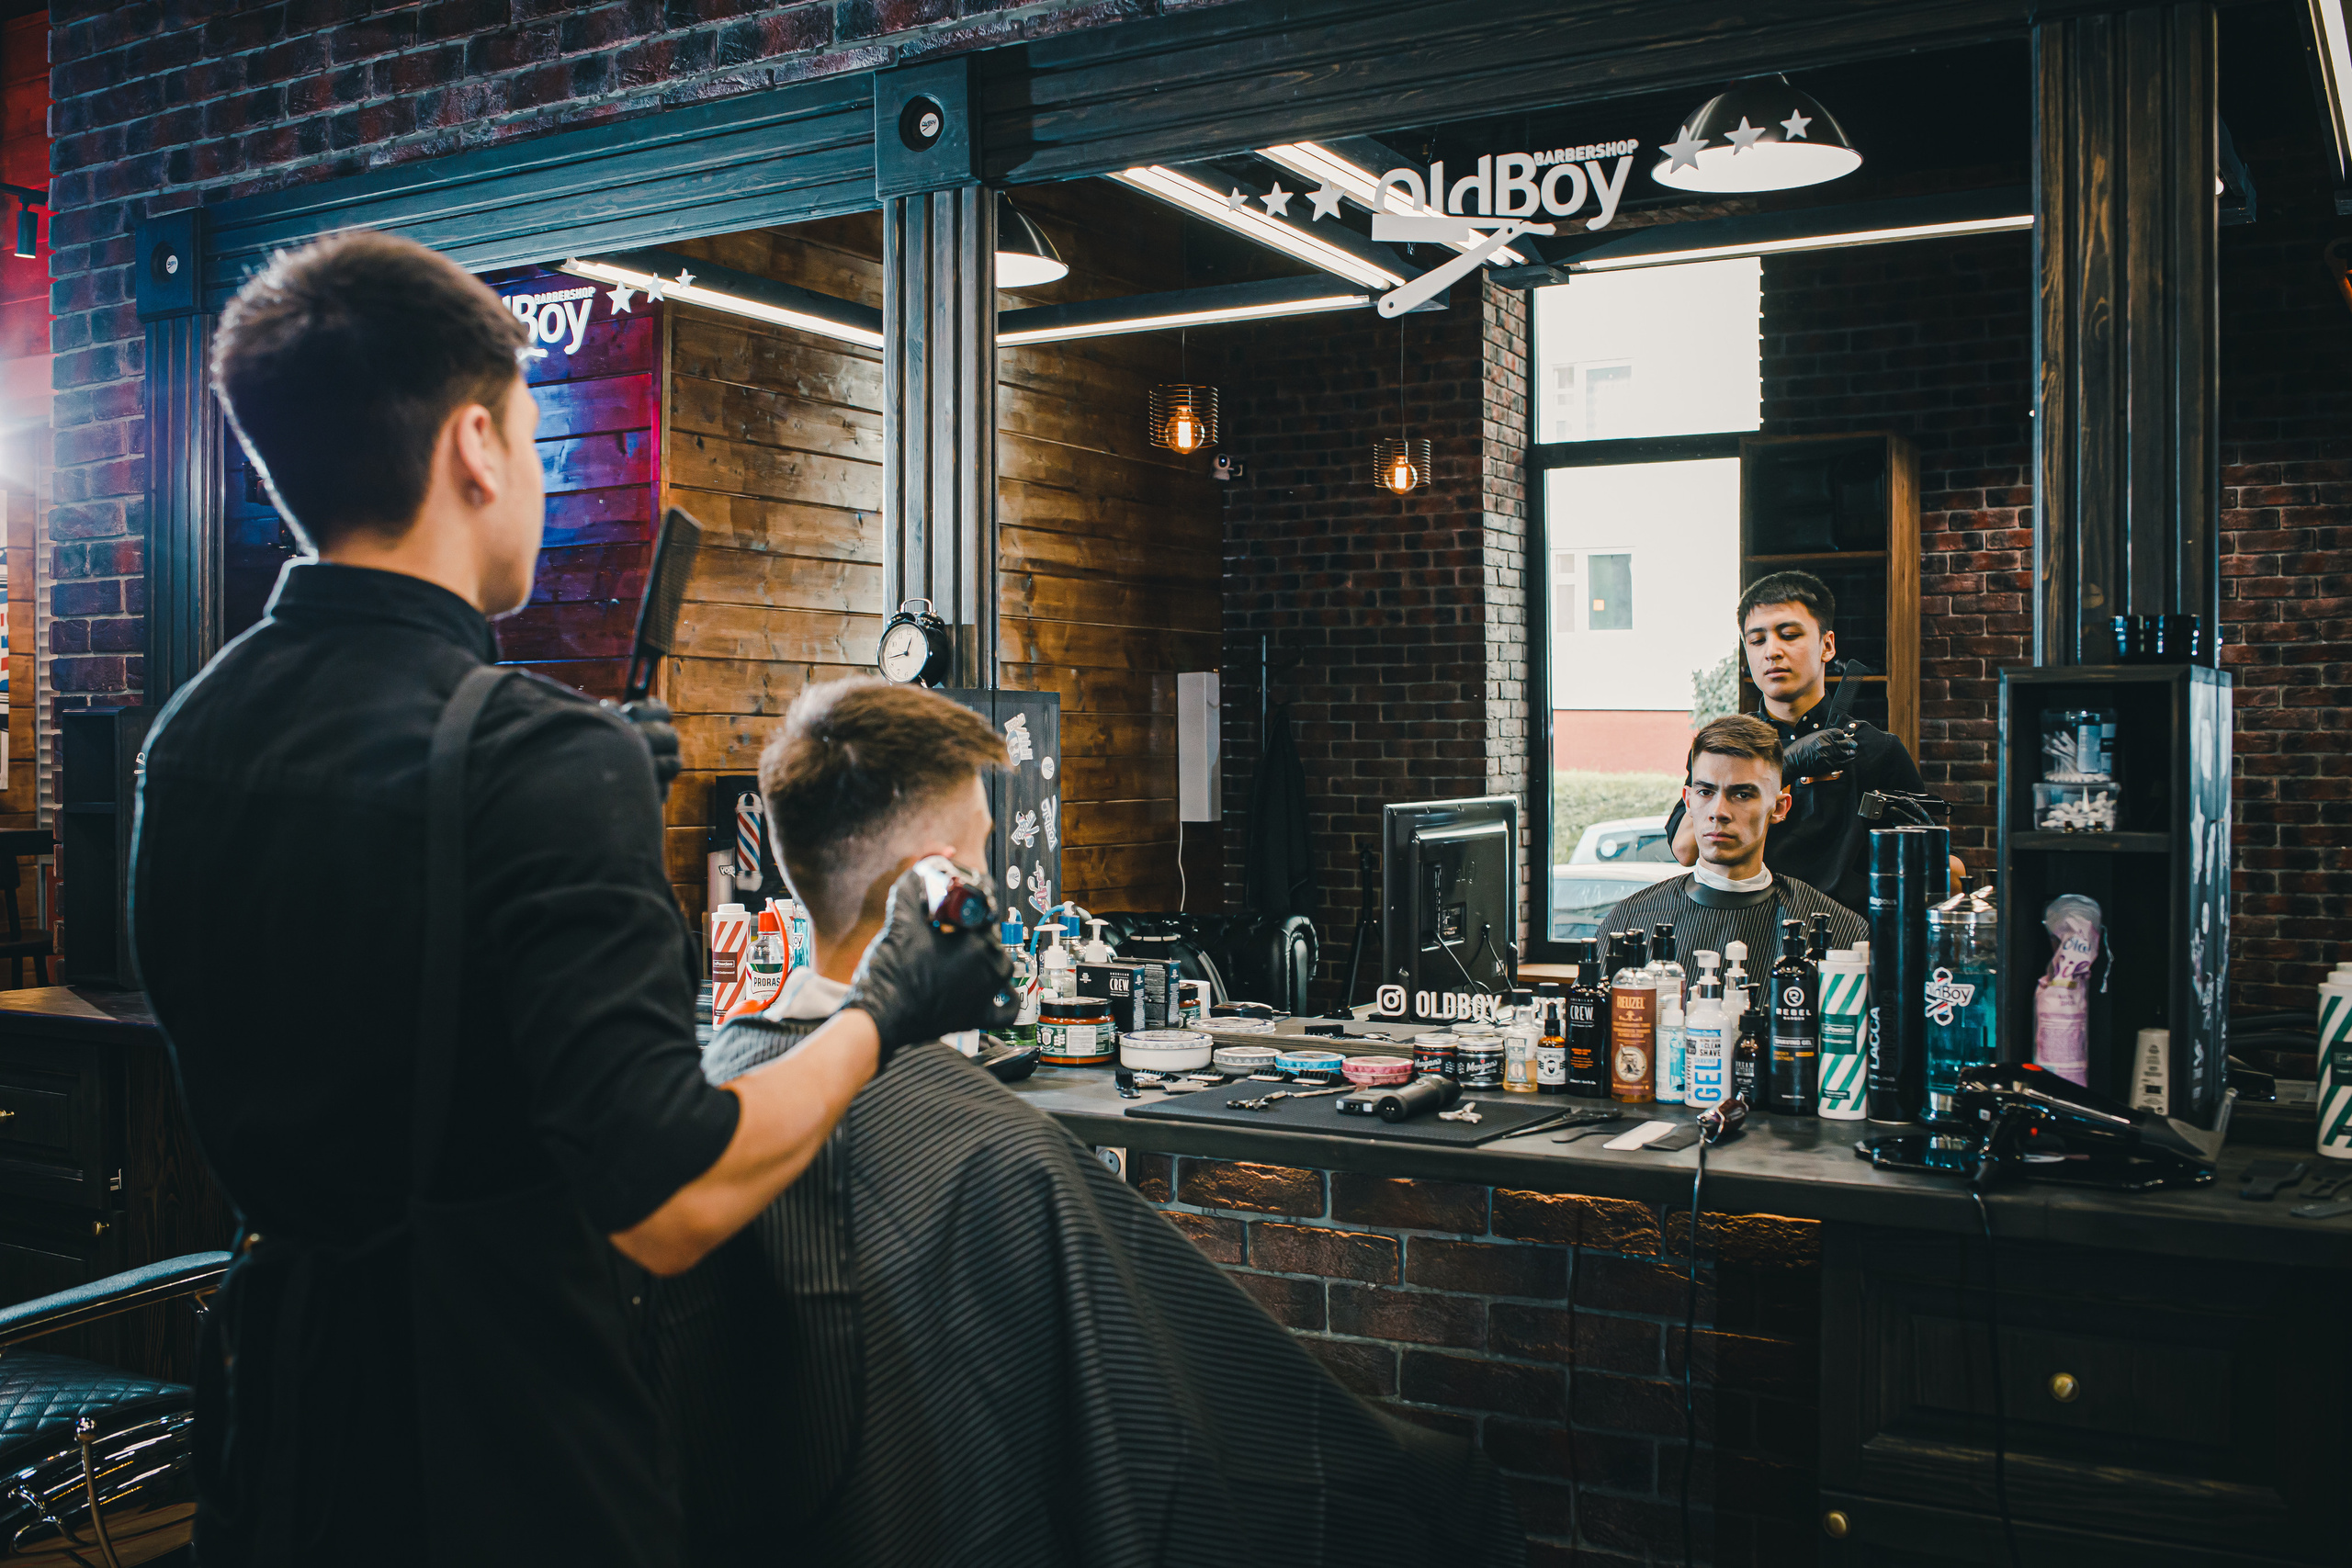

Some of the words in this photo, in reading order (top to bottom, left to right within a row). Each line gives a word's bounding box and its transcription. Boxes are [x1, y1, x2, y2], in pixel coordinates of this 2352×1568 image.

[1533, 139, 1640, 166] BARBERSHOP
[1373, 152, 1634, 231] OldBoy
[534, 286, 596, 305] BARBERSHOP
[753, 976, 781, 987] PRORAS
[1415, 990, 1502, 1023] OLDBOY
[1617, 995, 1645, 1009] REUZEL
[1775, 1007, 1812, 1016] REBEL
[1869, 1007, 1881, 1071] LACCA
[1700, 1048, 1721, 1056] SHAVE
[1694, 1058, 1722, 1101] GEL
